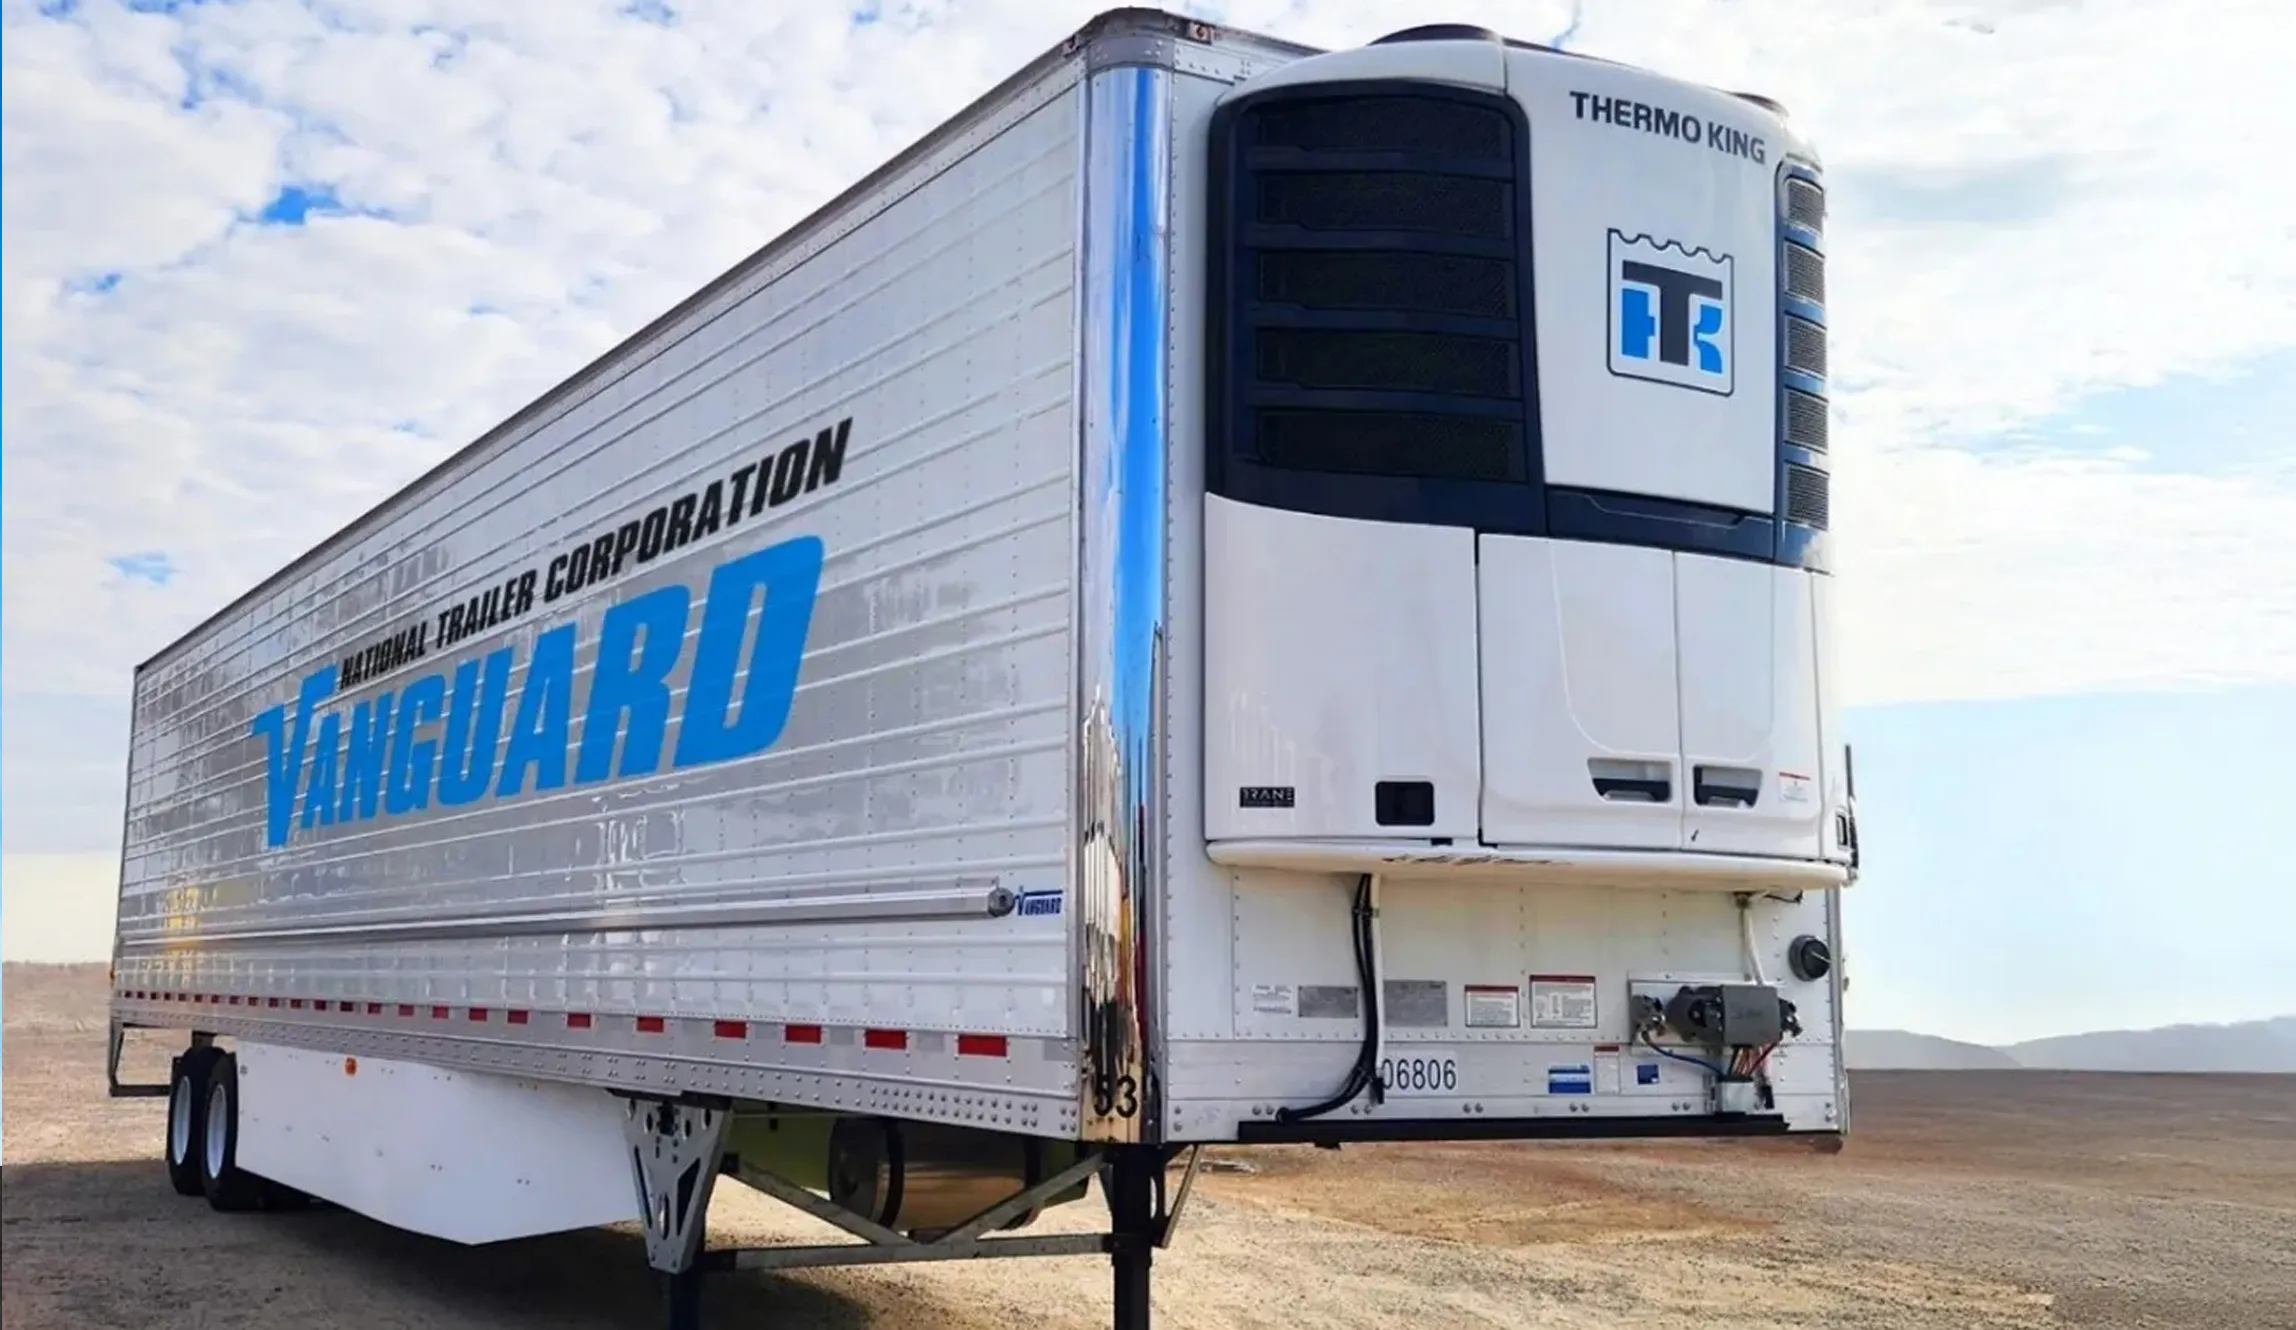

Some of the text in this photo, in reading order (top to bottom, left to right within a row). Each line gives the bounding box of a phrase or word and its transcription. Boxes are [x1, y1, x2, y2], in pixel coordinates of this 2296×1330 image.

[1569, 91, 1766, 165] THERMO KING
[339, 416, 853, 690] NATIONAL TRAILER CORPORATION
[252, 534, 825, 847] VANGUARD
[1381, 1058, 1457, 1091] 06806
